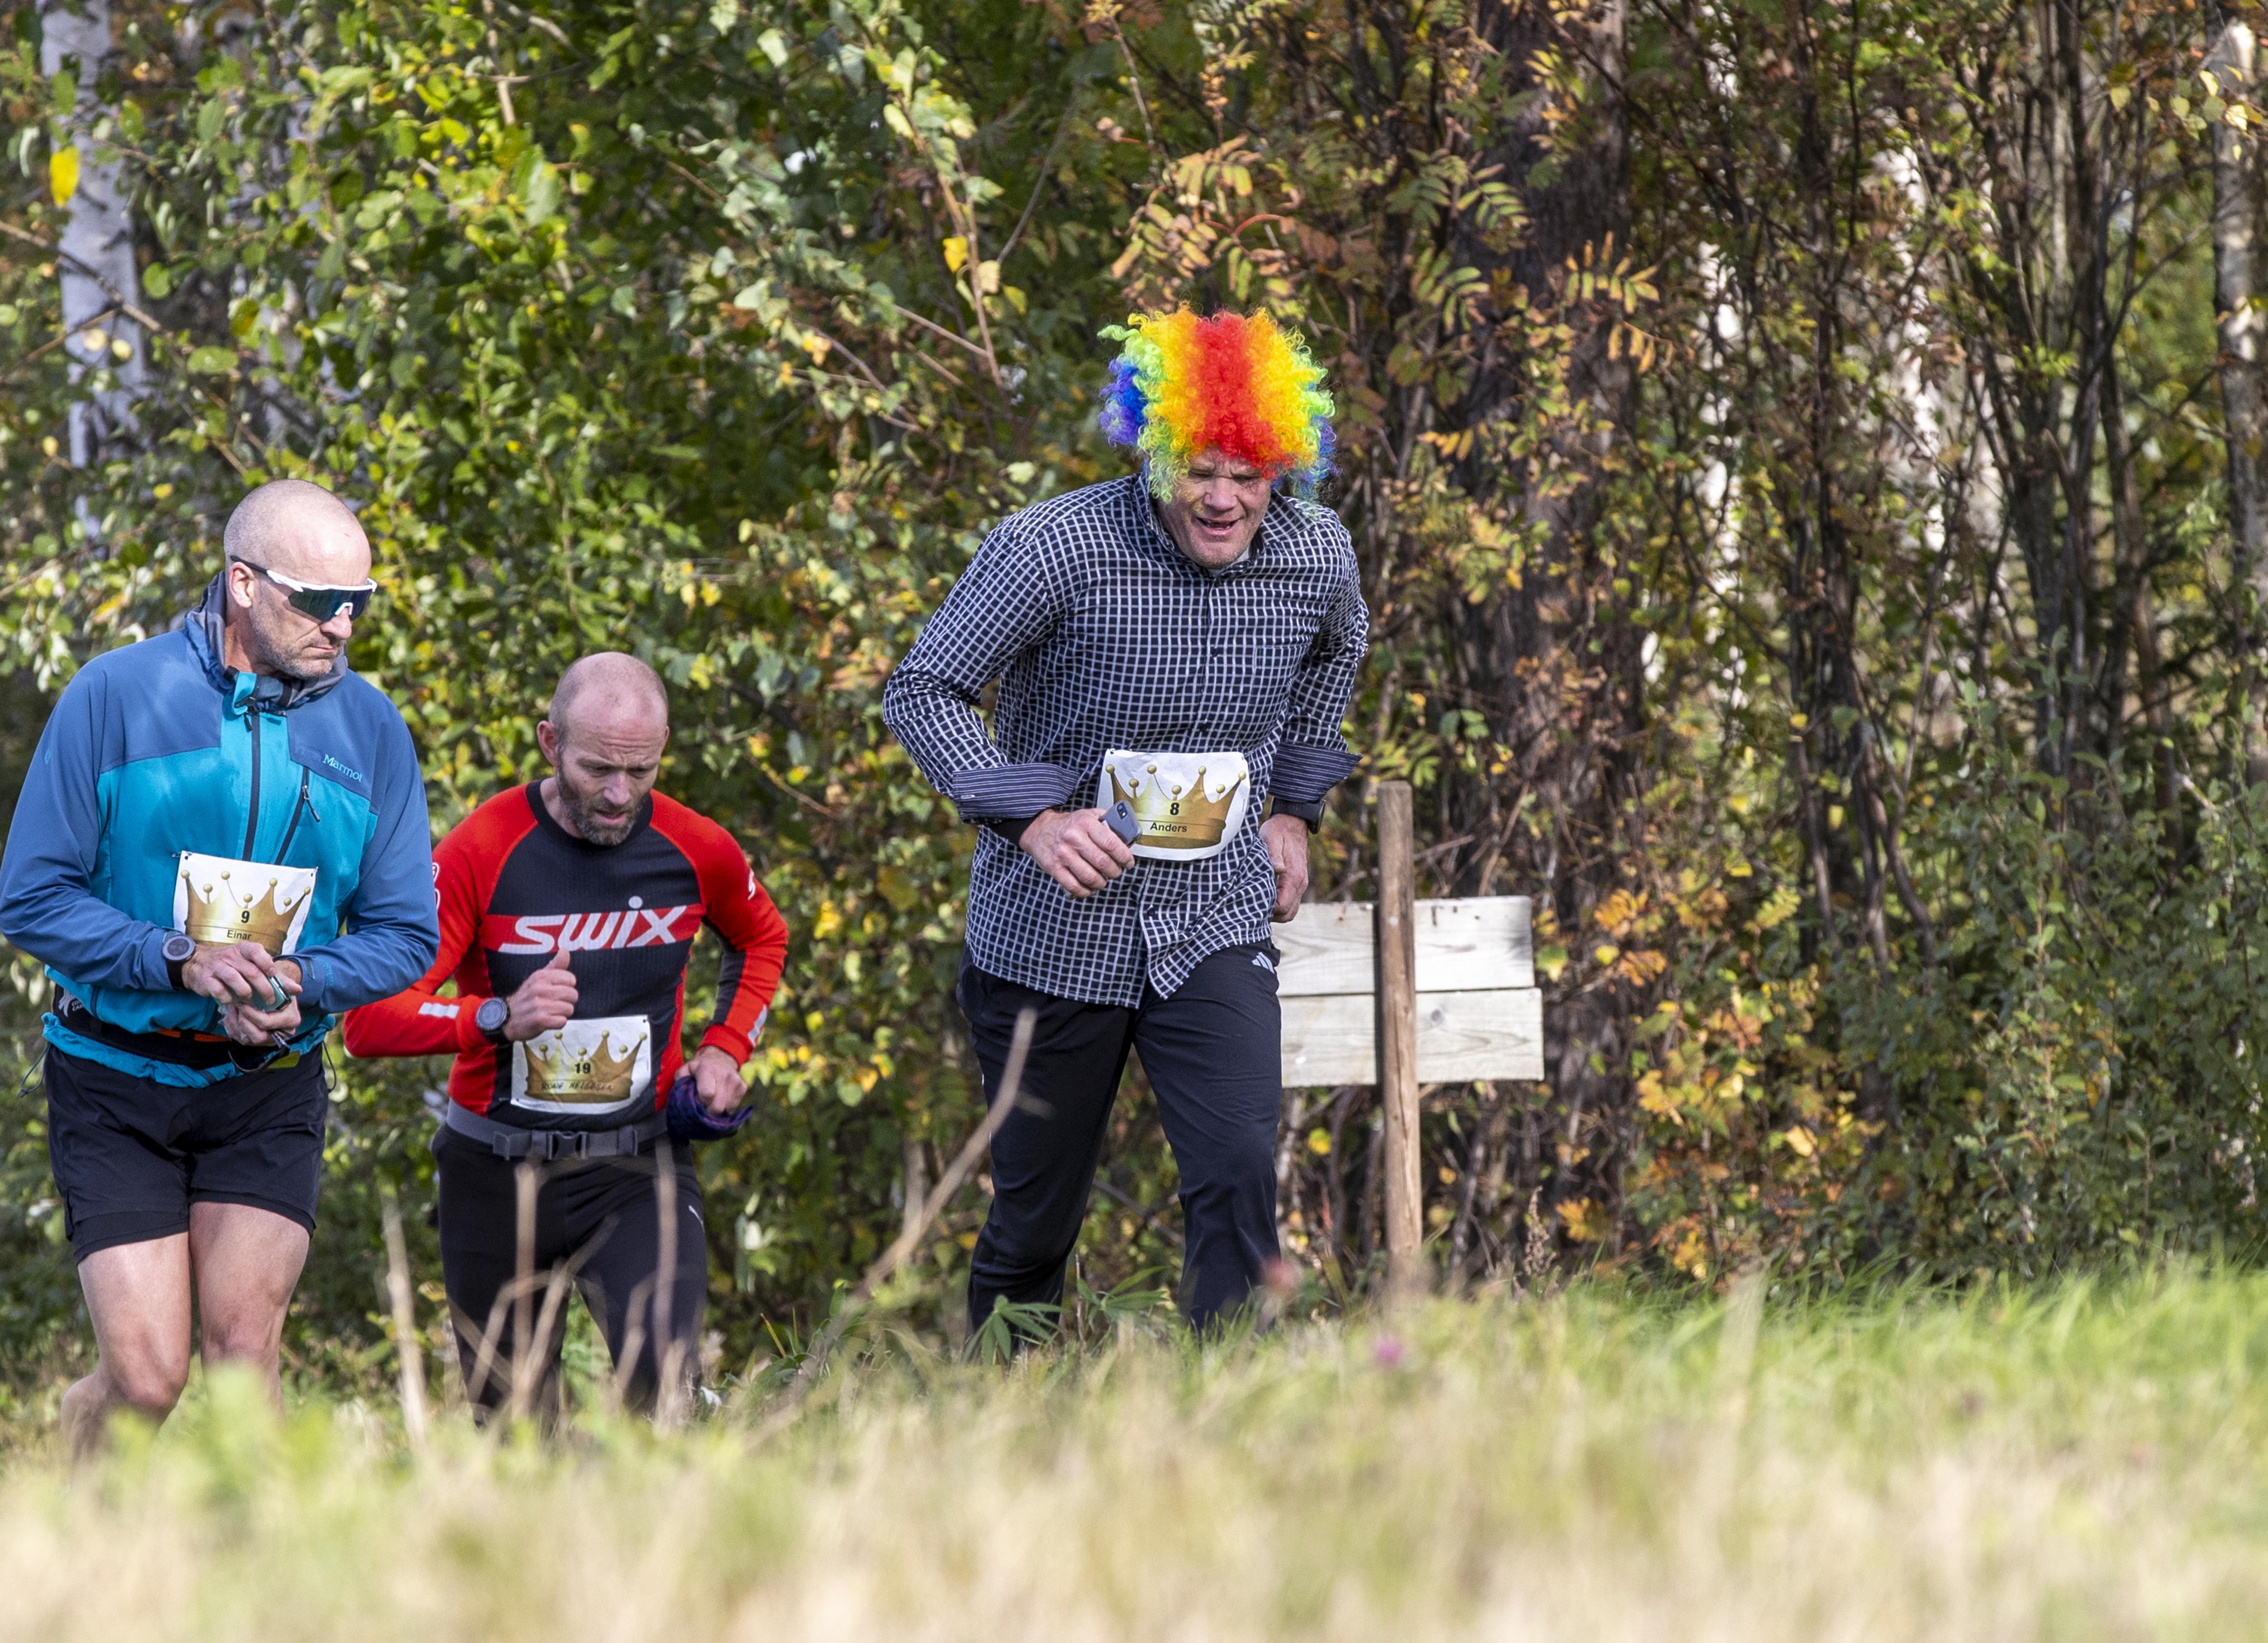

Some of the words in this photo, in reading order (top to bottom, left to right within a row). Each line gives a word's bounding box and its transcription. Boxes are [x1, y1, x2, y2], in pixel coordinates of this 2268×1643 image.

[322, 753, 362, 782] Marmot
[1169, 802, 1180, 816] 8
[1150, 822, 1188, 833] Anders
[240, 910, 250, 924] 9
[226, 929, 252, 941] Einar
[574, 1062, 591, 1074] 19
